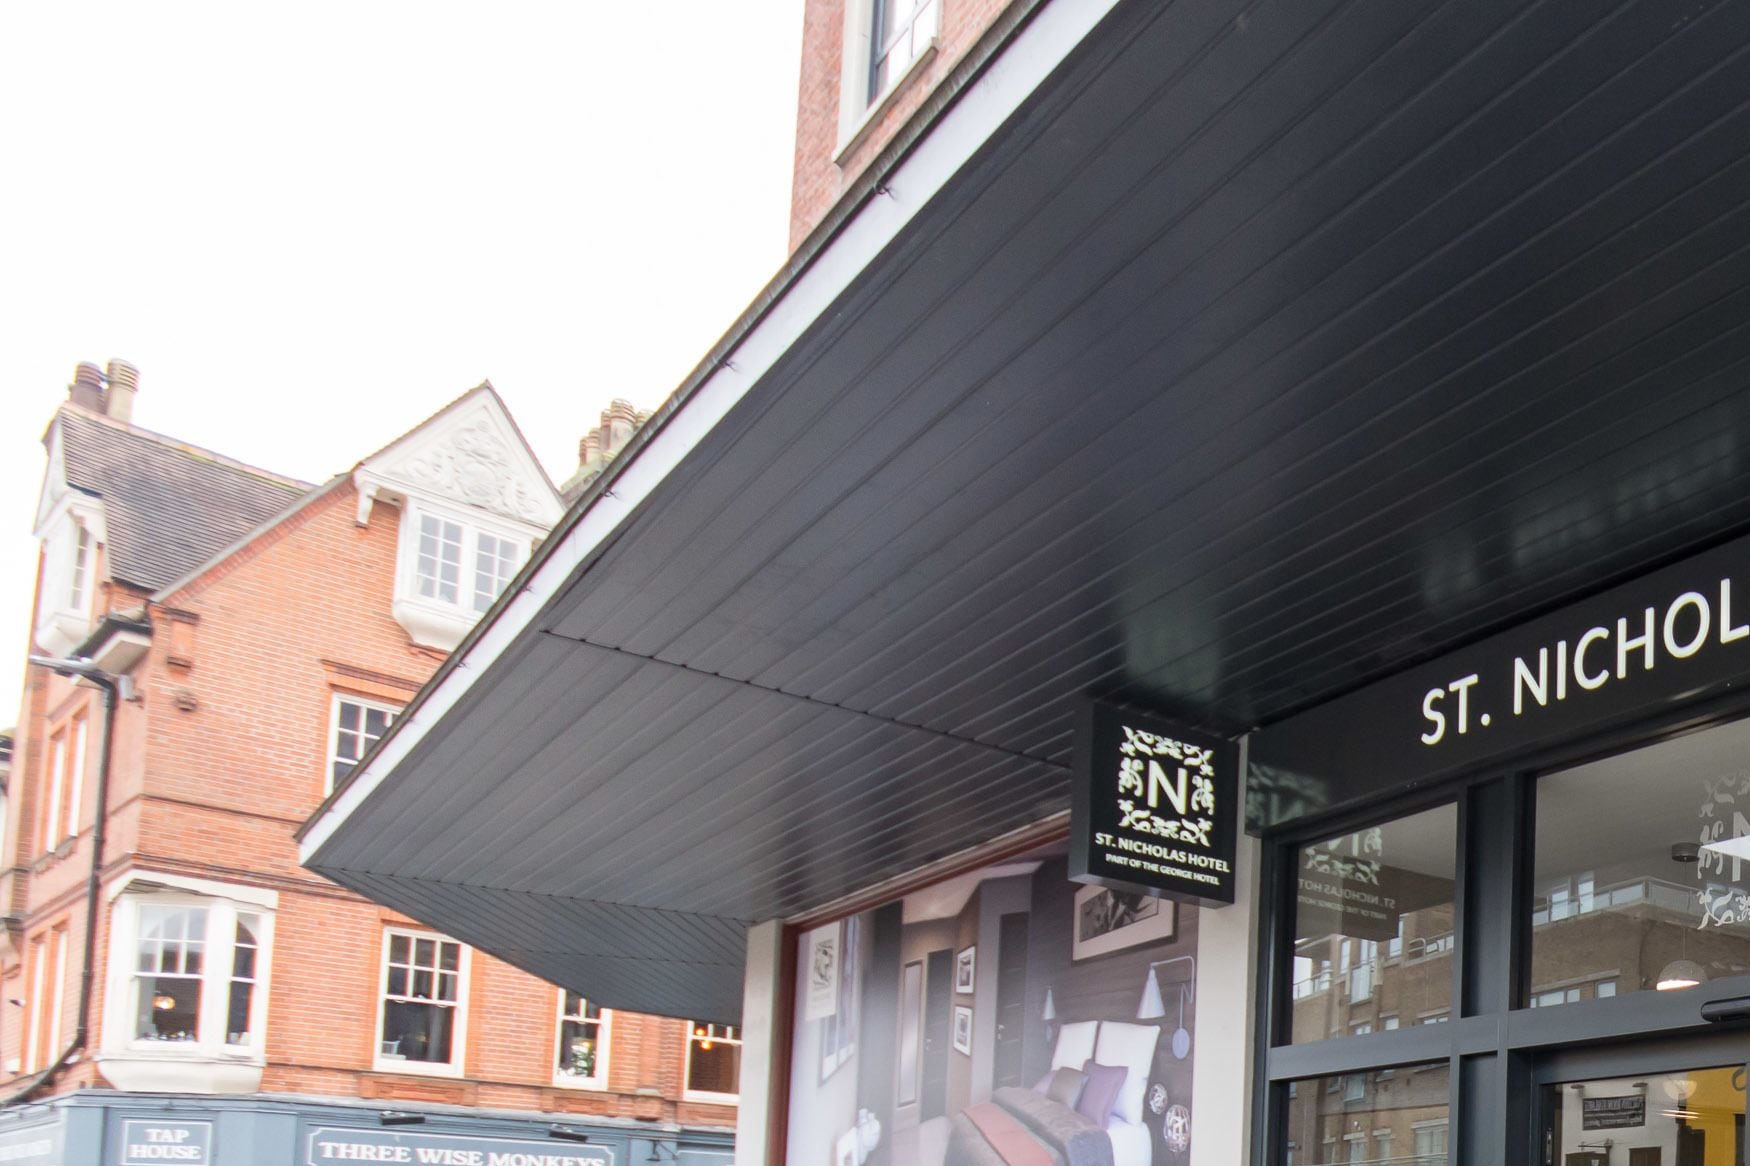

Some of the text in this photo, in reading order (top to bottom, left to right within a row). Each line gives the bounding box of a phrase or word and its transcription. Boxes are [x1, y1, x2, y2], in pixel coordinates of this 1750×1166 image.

[1420, 672, 1492, 746] ST.
[1095, 832, 1230, 873] ST. NICHOLAS HOTEL
[1105, 853, 1220, 886] PART OF THE GEORGE HOTEL
[144, 1128, 190, 1143] TAP
[128, 1144, 202, 1160] HOUSE
[318, 1141, 412, 1163] THREE
[415, 1148, 483, 1166] WISE
